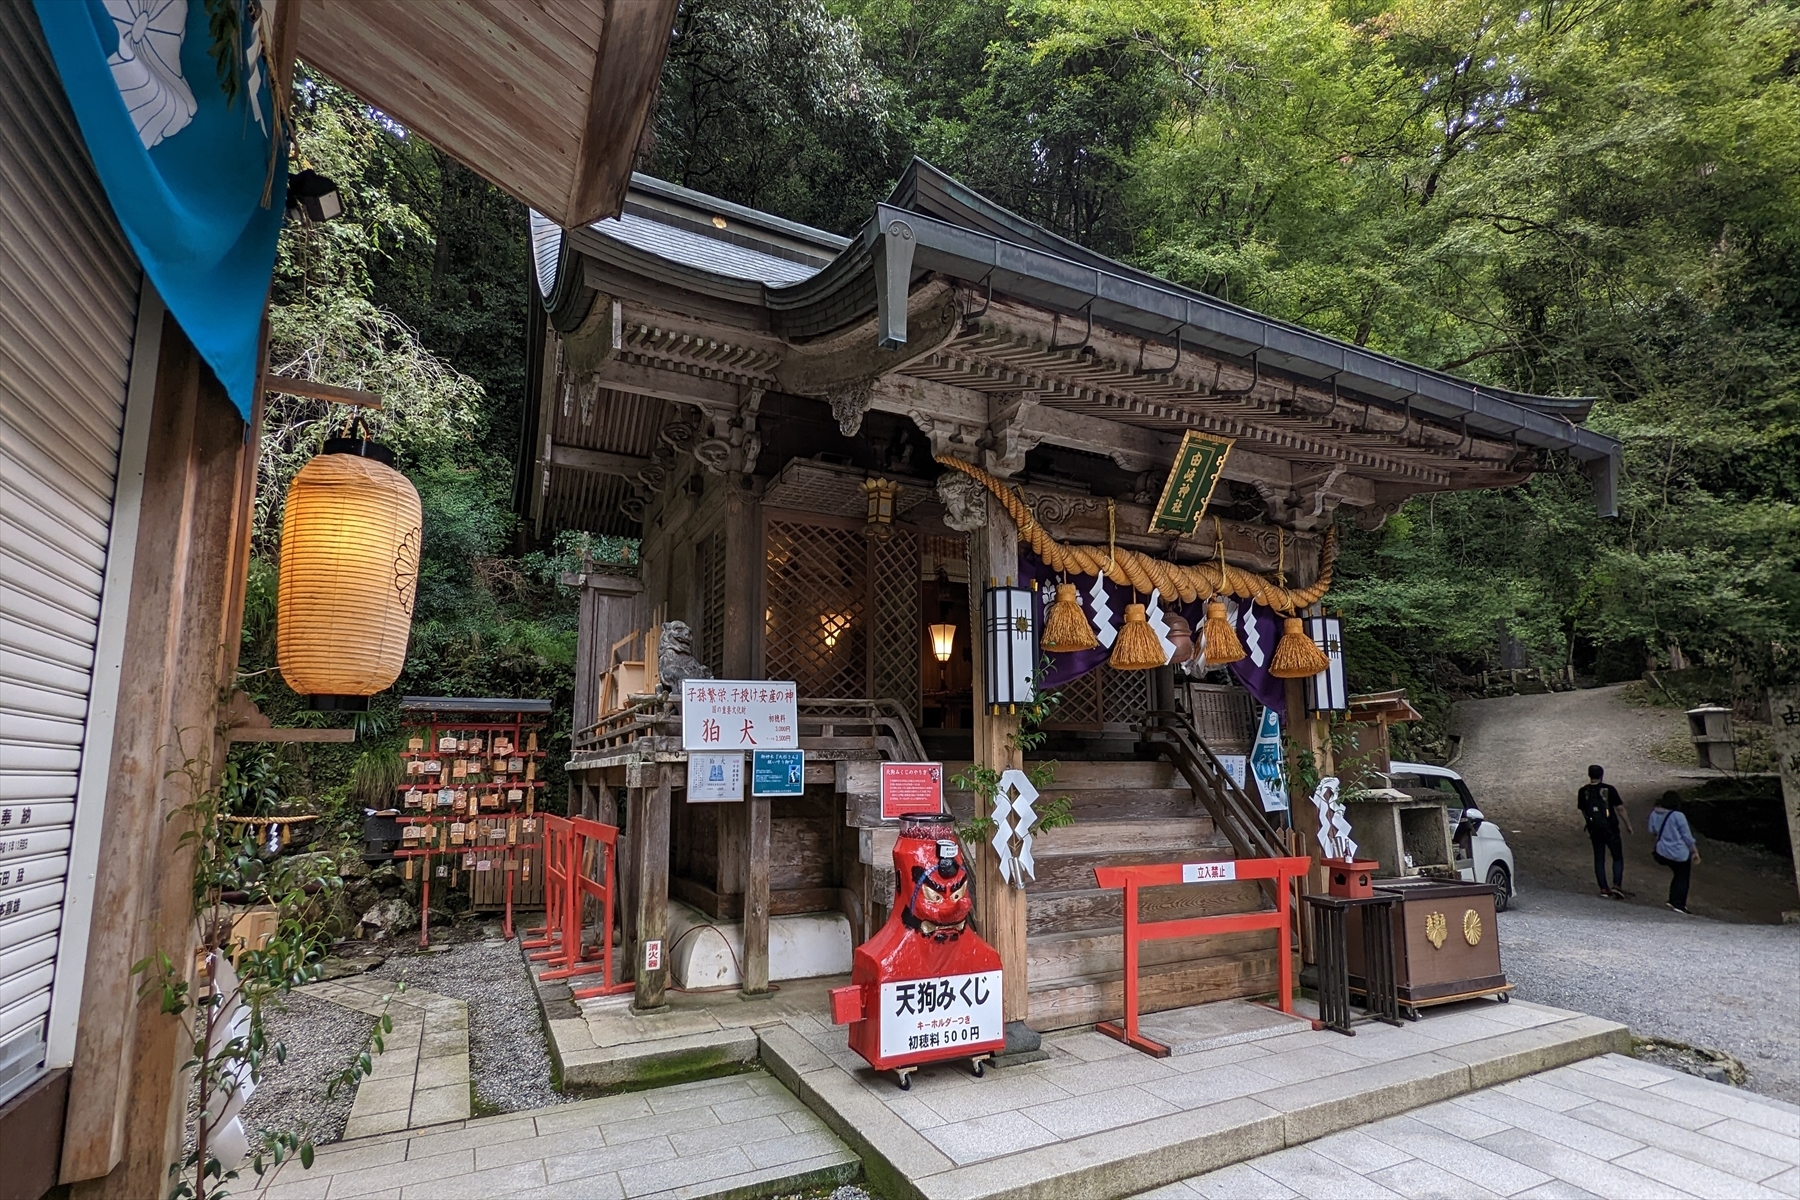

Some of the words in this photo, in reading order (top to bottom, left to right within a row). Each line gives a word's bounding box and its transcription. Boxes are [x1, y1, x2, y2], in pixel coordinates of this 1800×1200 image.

[1197, 865, 1226, 878] 立入禁止
[648, 942, 659, 968] 消火器
[895, 976, 991, 1018] 天狗みくじ
[917, 1015, 971, 1031] キーホルダーつき
